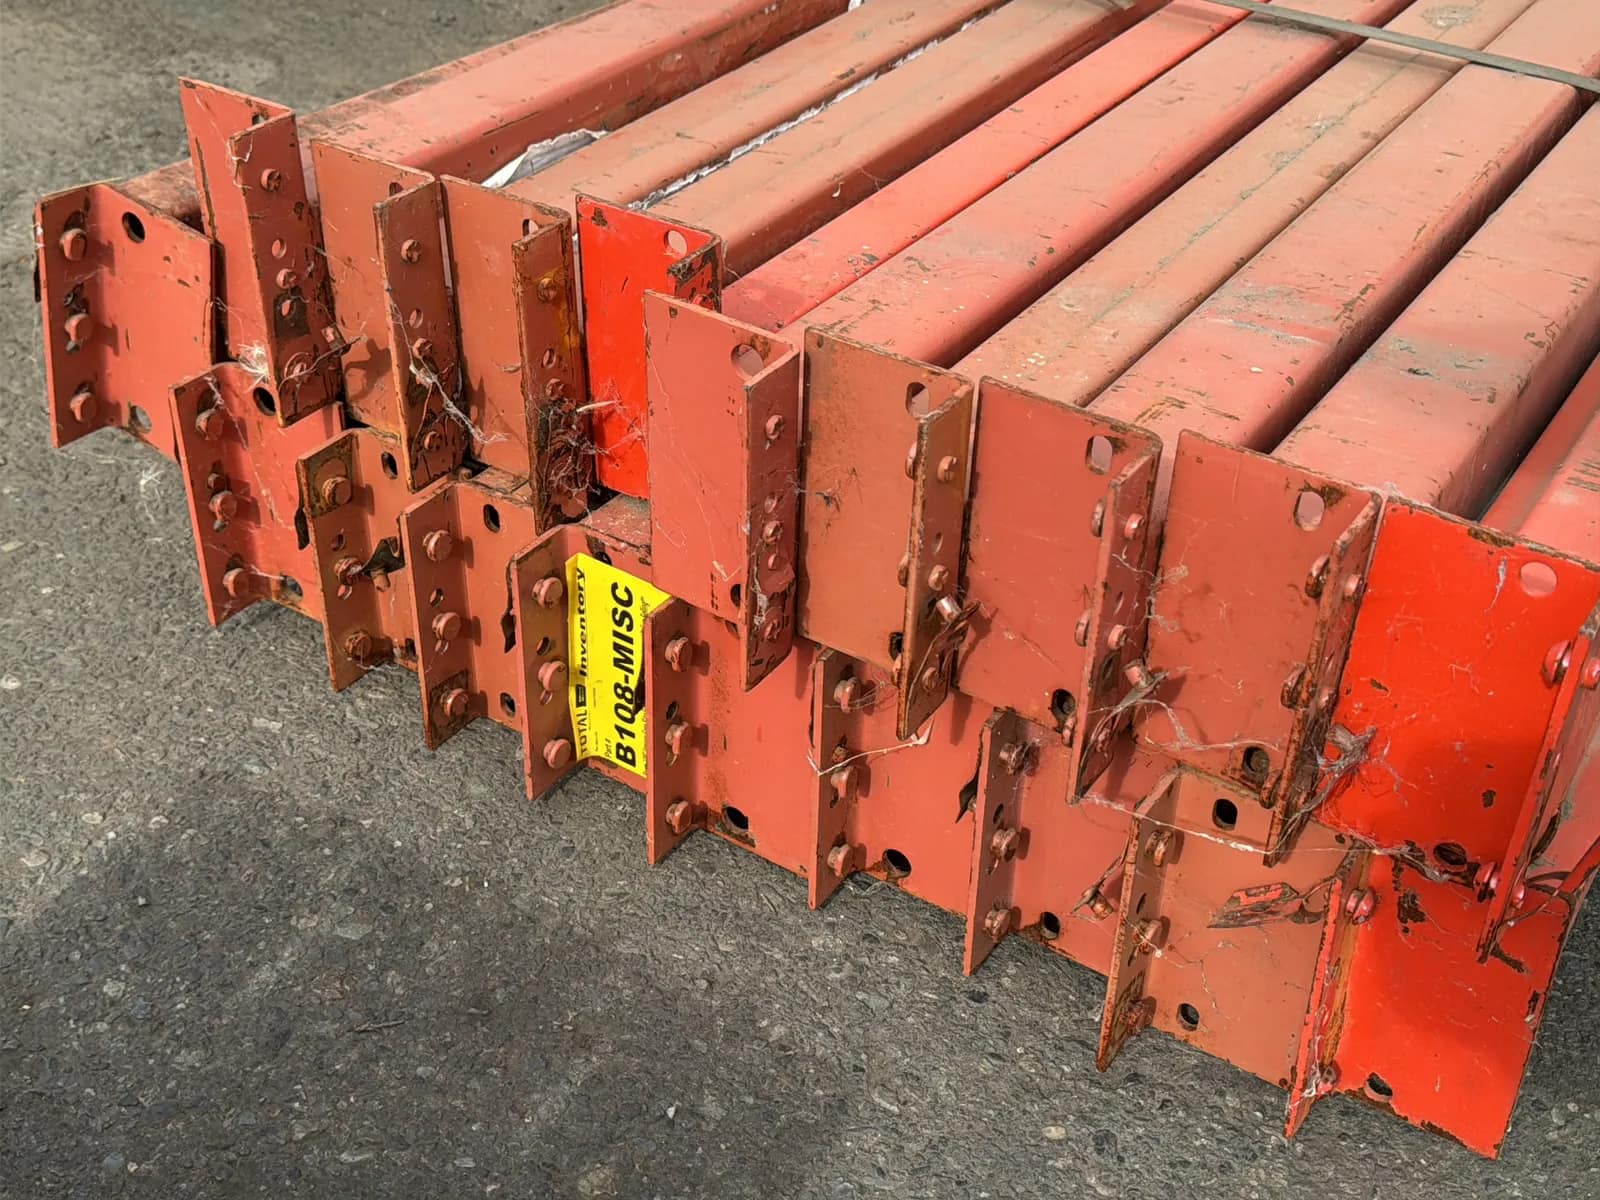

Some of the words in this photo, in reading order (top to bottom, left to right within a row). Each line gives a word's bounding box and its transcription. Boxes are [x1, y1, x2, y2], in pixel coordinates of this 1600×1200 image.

[577, 568, 587, 677] Inventory
[611, 582, 636, 767] B108-MISC
[576, 710, 587, 755] TOTAL
[604, 745, 612, 758] Part
